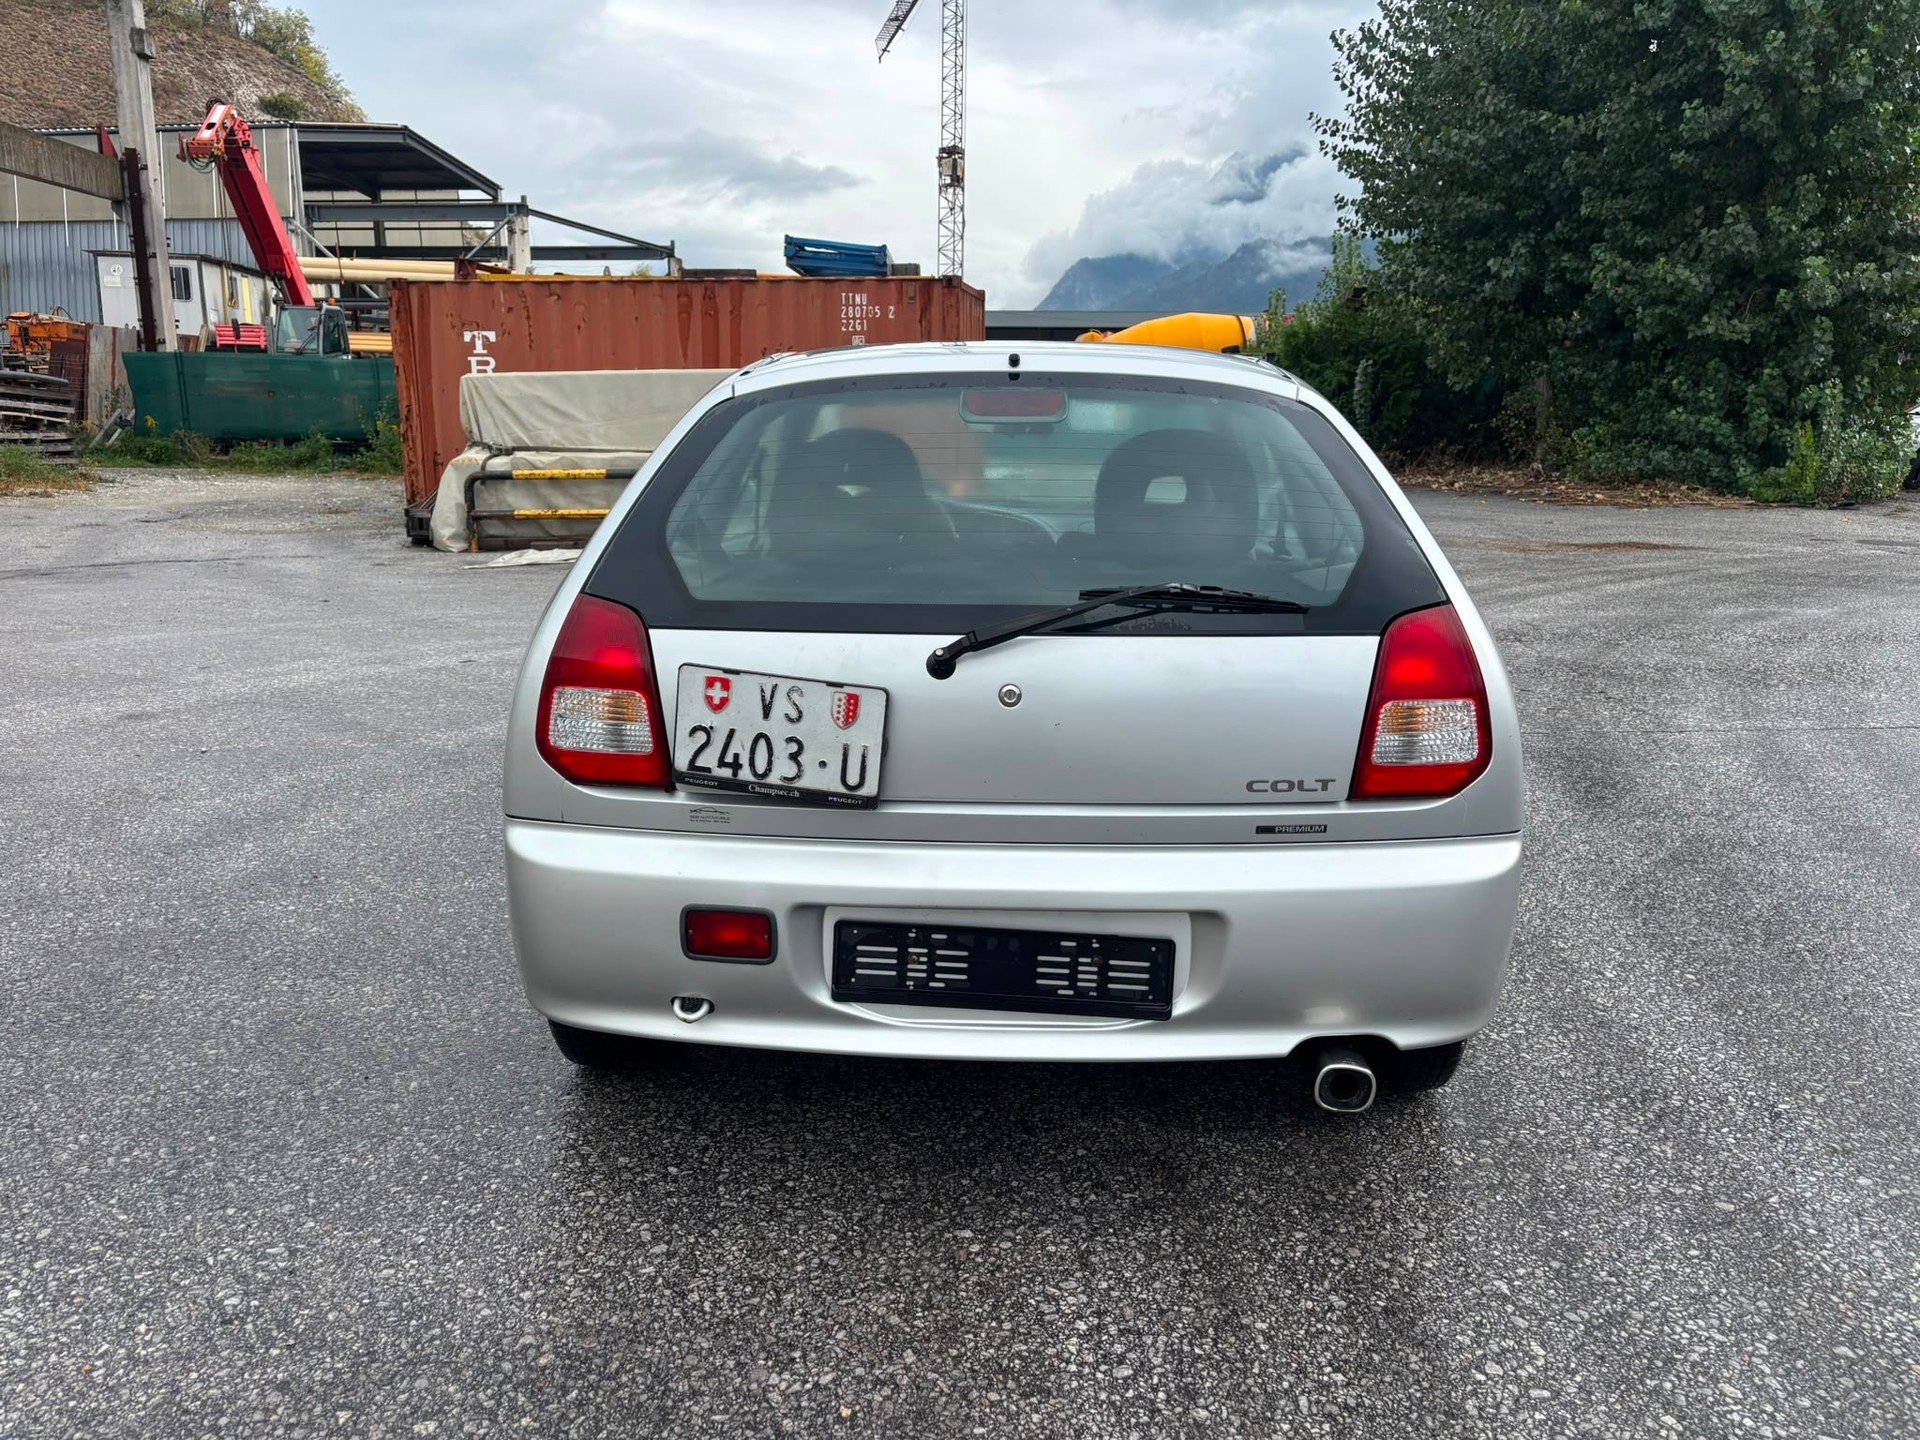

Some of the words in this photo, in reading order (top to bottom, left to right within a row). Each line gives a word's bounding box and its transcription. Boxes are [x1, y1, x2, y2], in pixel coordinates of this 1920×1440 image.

[841, 293, 867, 305] TTNU
[888, 305, 896, 319] 2
[758, 682, 805, 724] VS
[684, 777, 719, 787] PEUGEOT
[1246, 779, 1336, 793] COLT
[748, 783, 801, 797] Champsec.ch
[828, 796, 863, 805] PEUGEOT
[1275, 824, 1325, 833] PREMIUM
